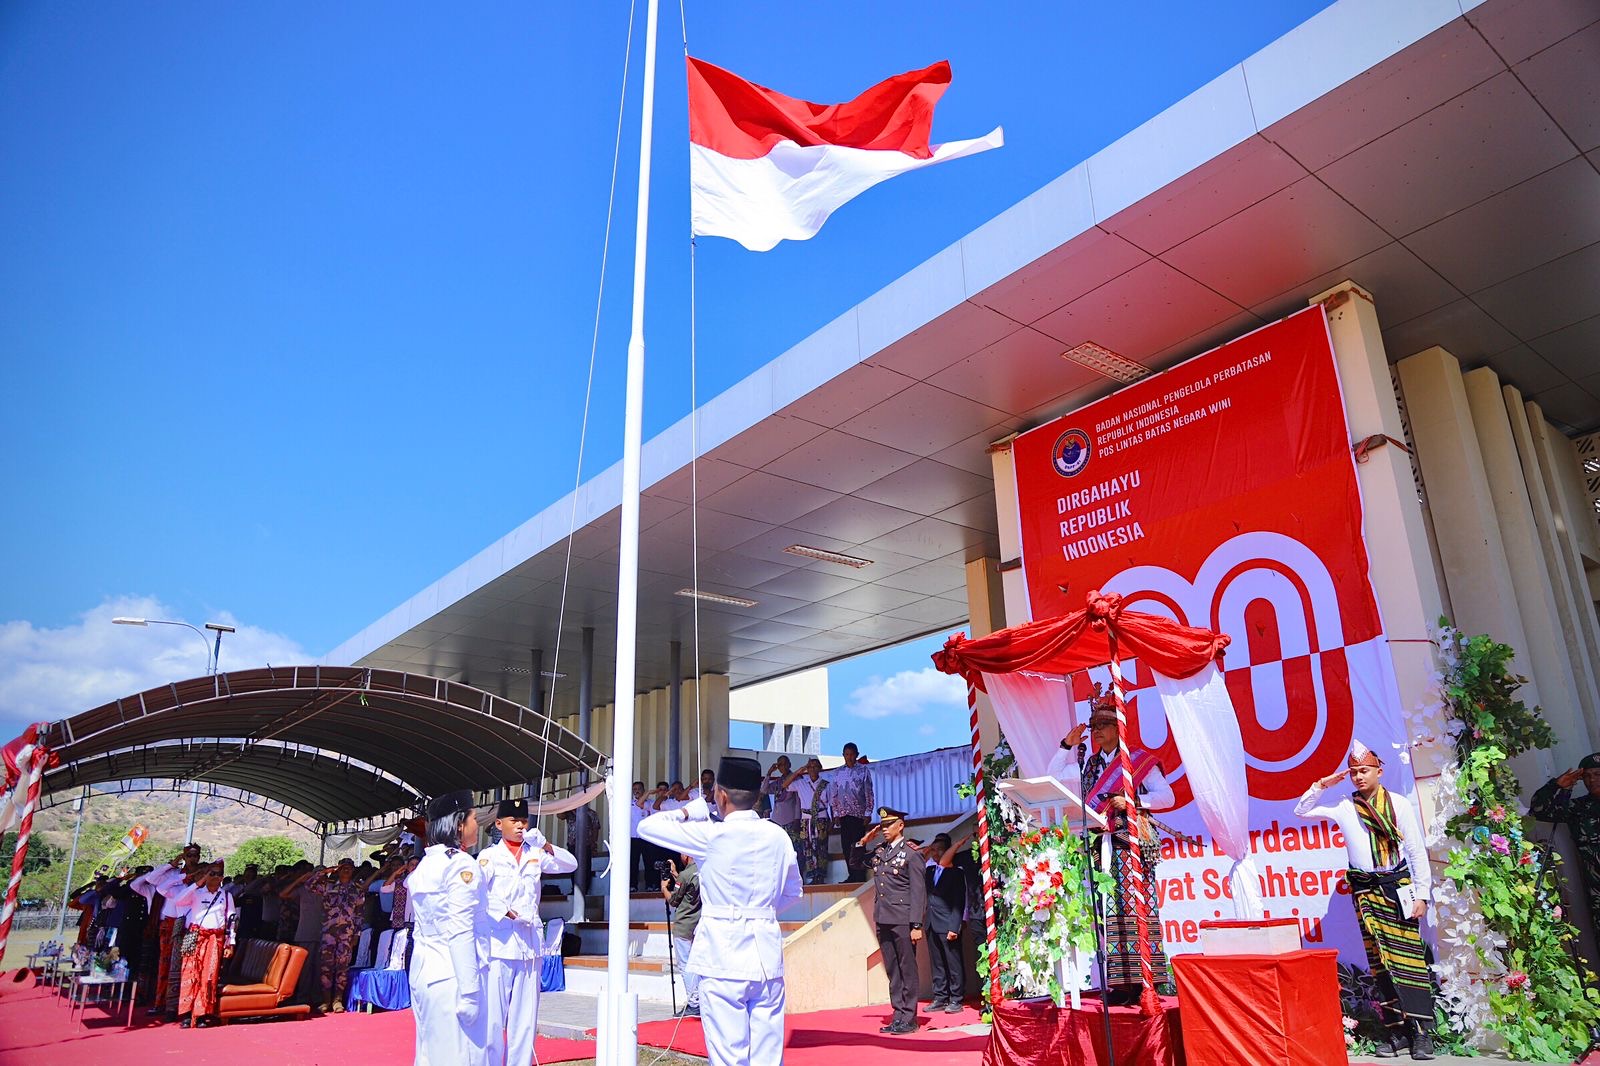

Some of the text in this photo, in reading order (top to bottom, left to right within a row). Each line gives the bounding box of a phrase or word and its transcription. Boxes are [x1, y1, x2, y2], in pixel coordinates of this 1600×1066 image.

[1095, 350, 1272, 433] BADAN NASIONAL PENGELOLA PERBATASAN
[1097, 405, 1180, 445] REPUBLIK INDONESIA
[1099, 397, 1232, 458] POS LINTAS BATAS NEGARA WINI
[1057, 469, 1141, 514] DIRGAHAYU
[1059, 499, 1132, 538] REPUBLIK
[1062, 521, 1145, 562] INDONESIA
[1160, 831, 1204, 860] atu
[1155, 871, 1196, 909] yat
